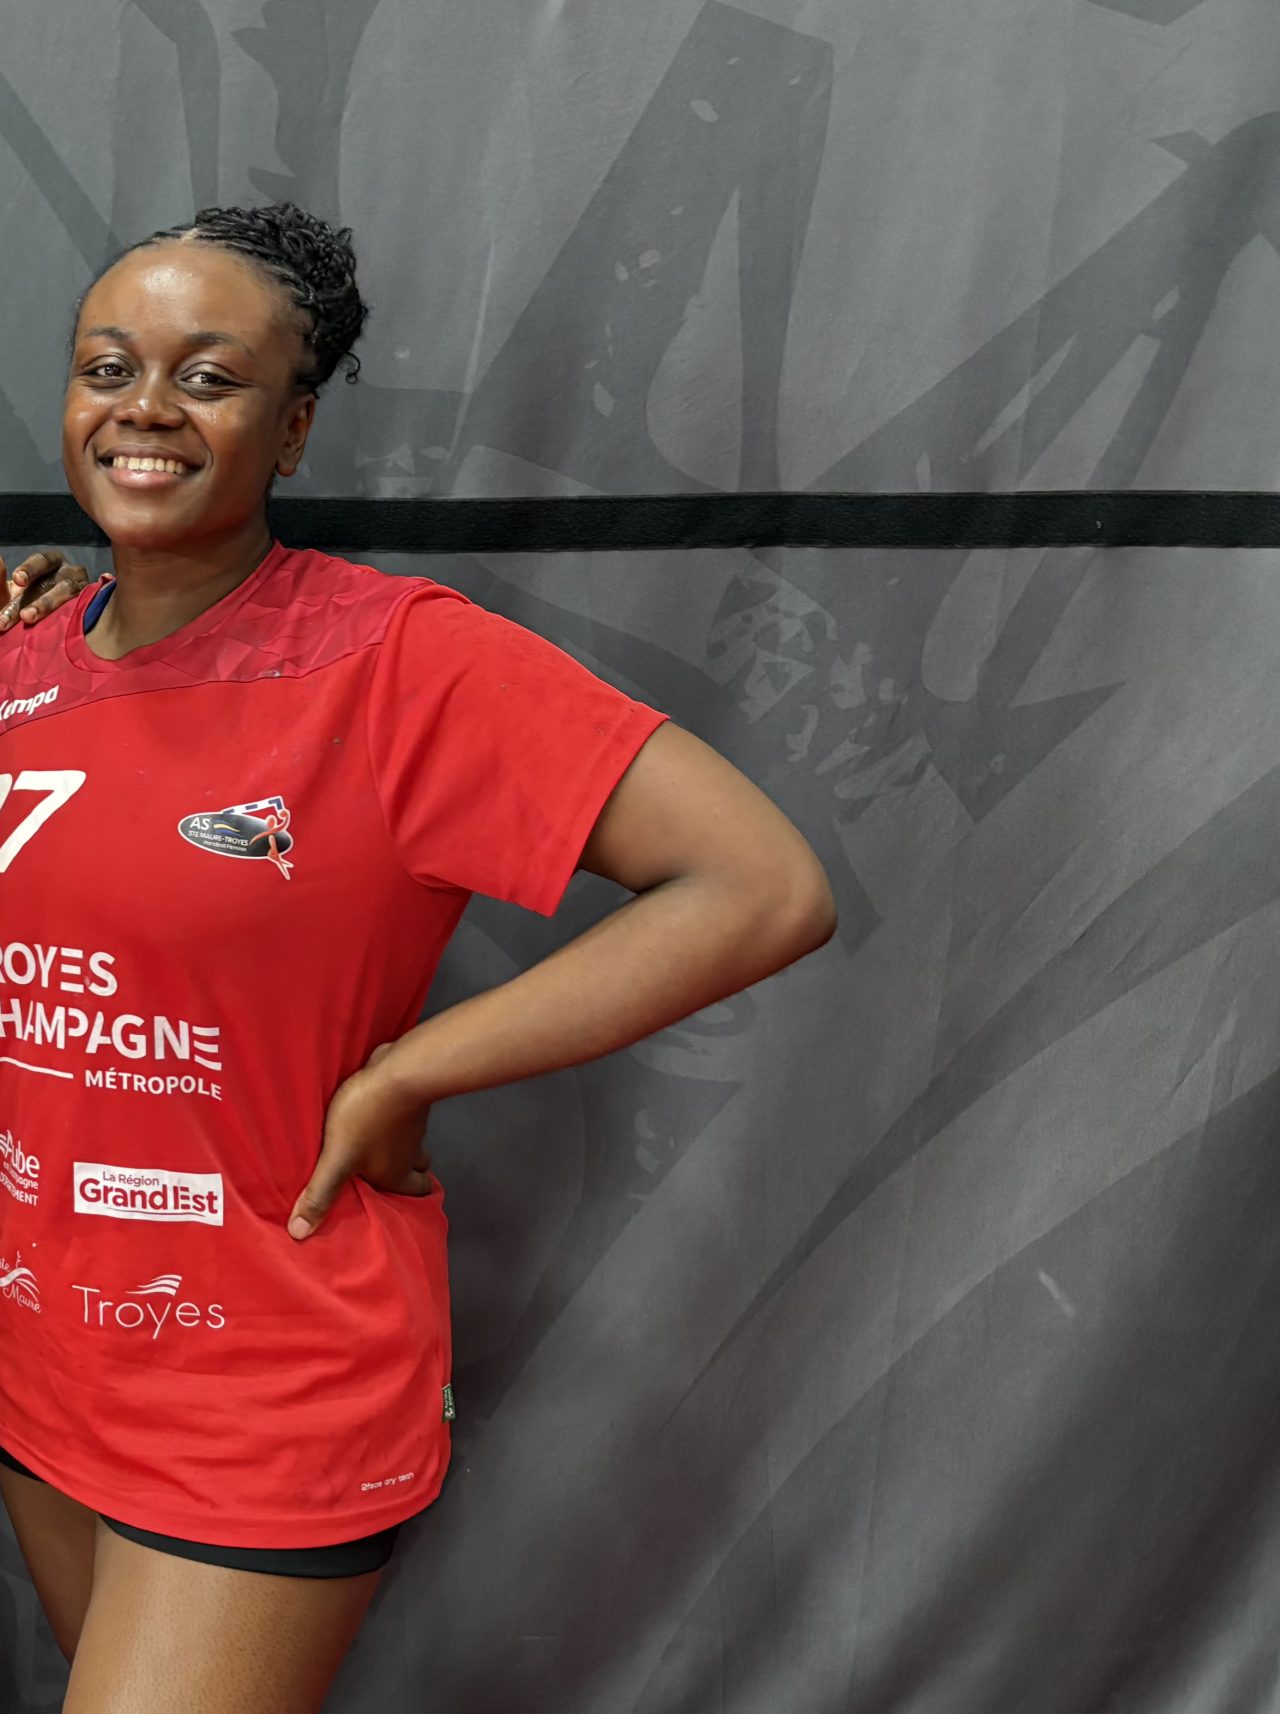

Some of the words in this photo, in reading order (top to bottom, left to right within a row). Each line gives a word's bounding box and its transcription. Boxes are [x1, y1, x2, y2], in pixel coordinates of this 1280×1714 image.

[190, 817, 210, 830] AS
[85, 1067, 222, 1101] MÉTROPOLE
[102, 1171, 116, 1182] La
[118, 1174, 160, 1187] Région
[72, 1285, 225, 1339] Troyes
